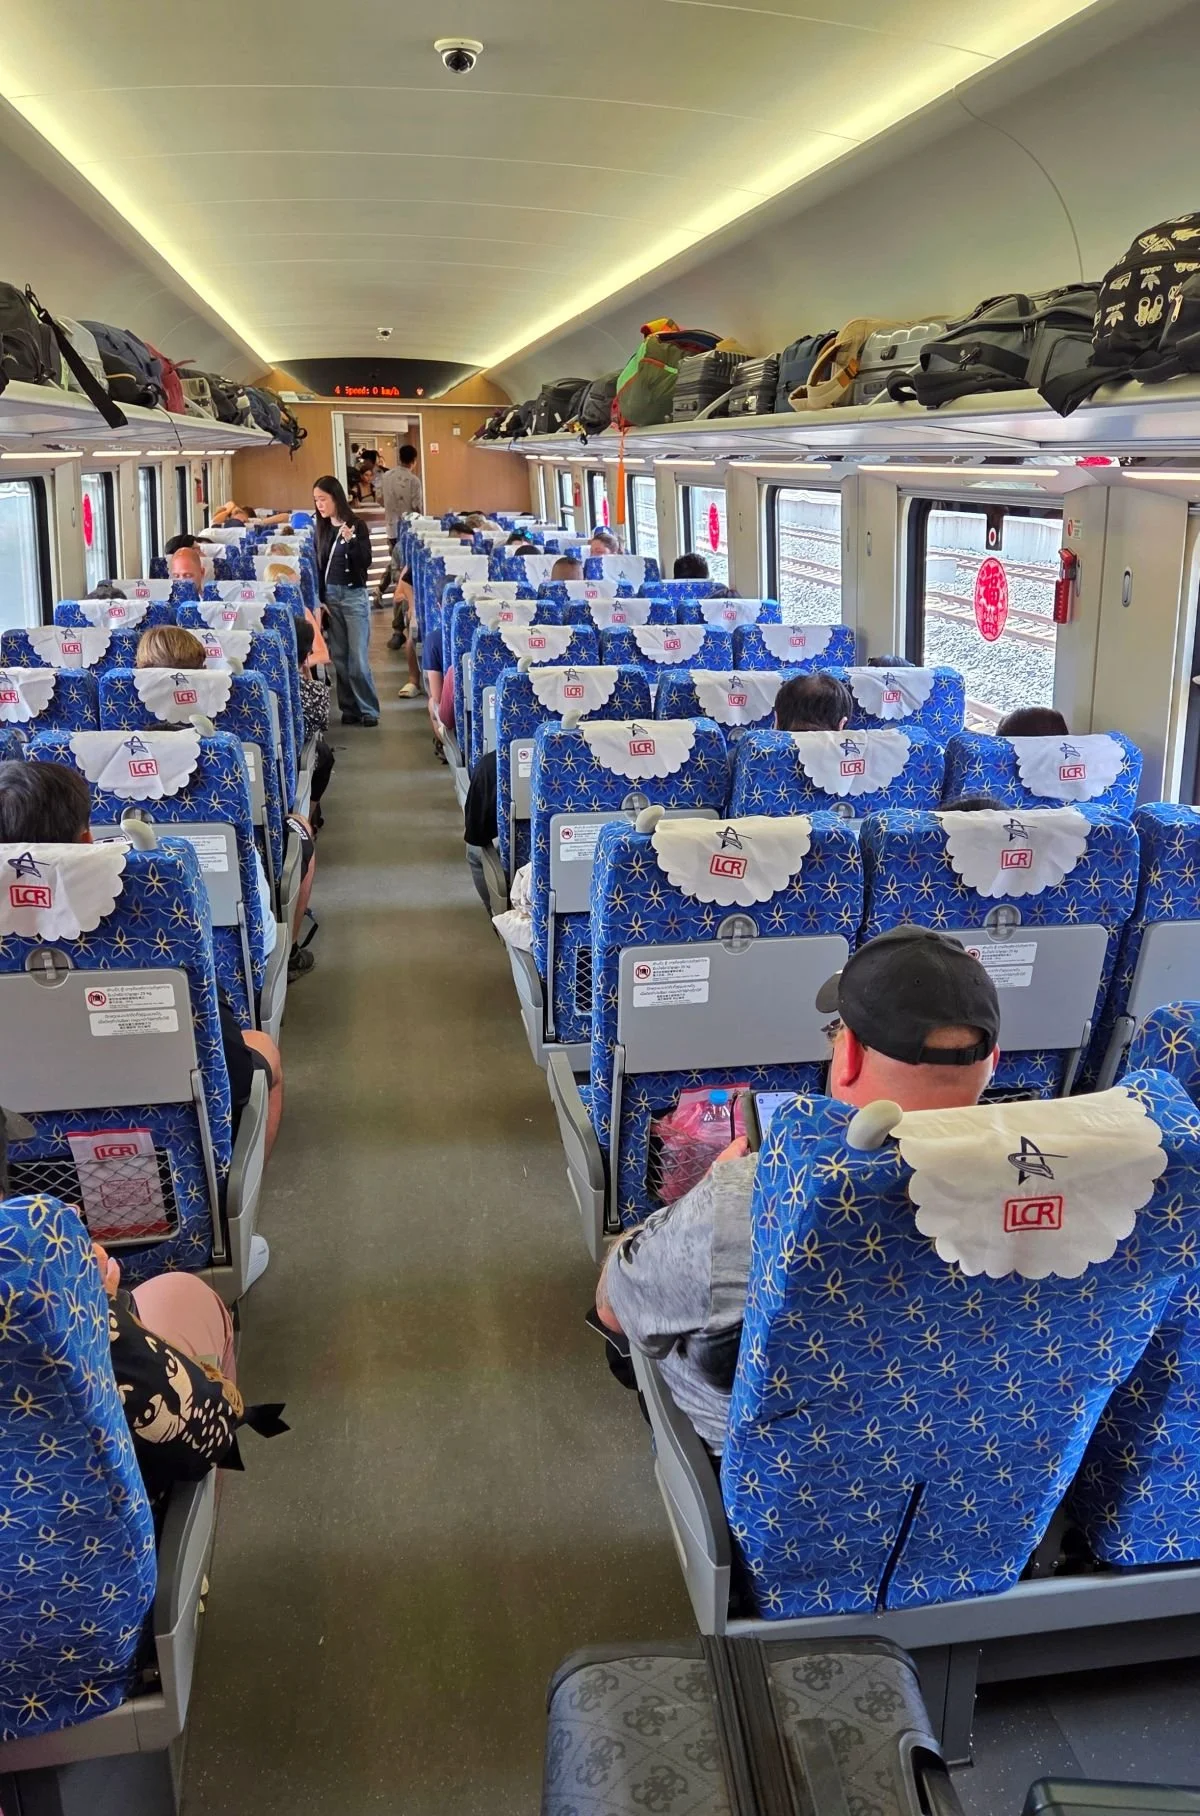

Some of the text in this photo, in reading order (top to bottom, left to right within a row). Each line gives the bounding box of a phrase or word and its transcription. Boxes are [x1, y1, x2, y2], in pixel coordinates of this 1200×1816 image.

[65, 644, 80, 652] LCR
[177, 692, 195, 702] LCR
[567, 687, 581, 696] LCR
[886, 691, 899, 701] LCR
[731, 696, 745, 704] LCR
[633, 742, 653, 753] LCR
[132, 762, 154, 774] LCR
[843, 762, 862, 773] LCR
[1063, 768, 1083, 778] LCR
[1005, 852, 1027, 866] LCR
[715, 858, 741, 875] LCR
[15, 888, 48, 905] LCR
[100, 1146, 135, 1158] LCR
[1011, 1201, 1056, 1227] LCR
